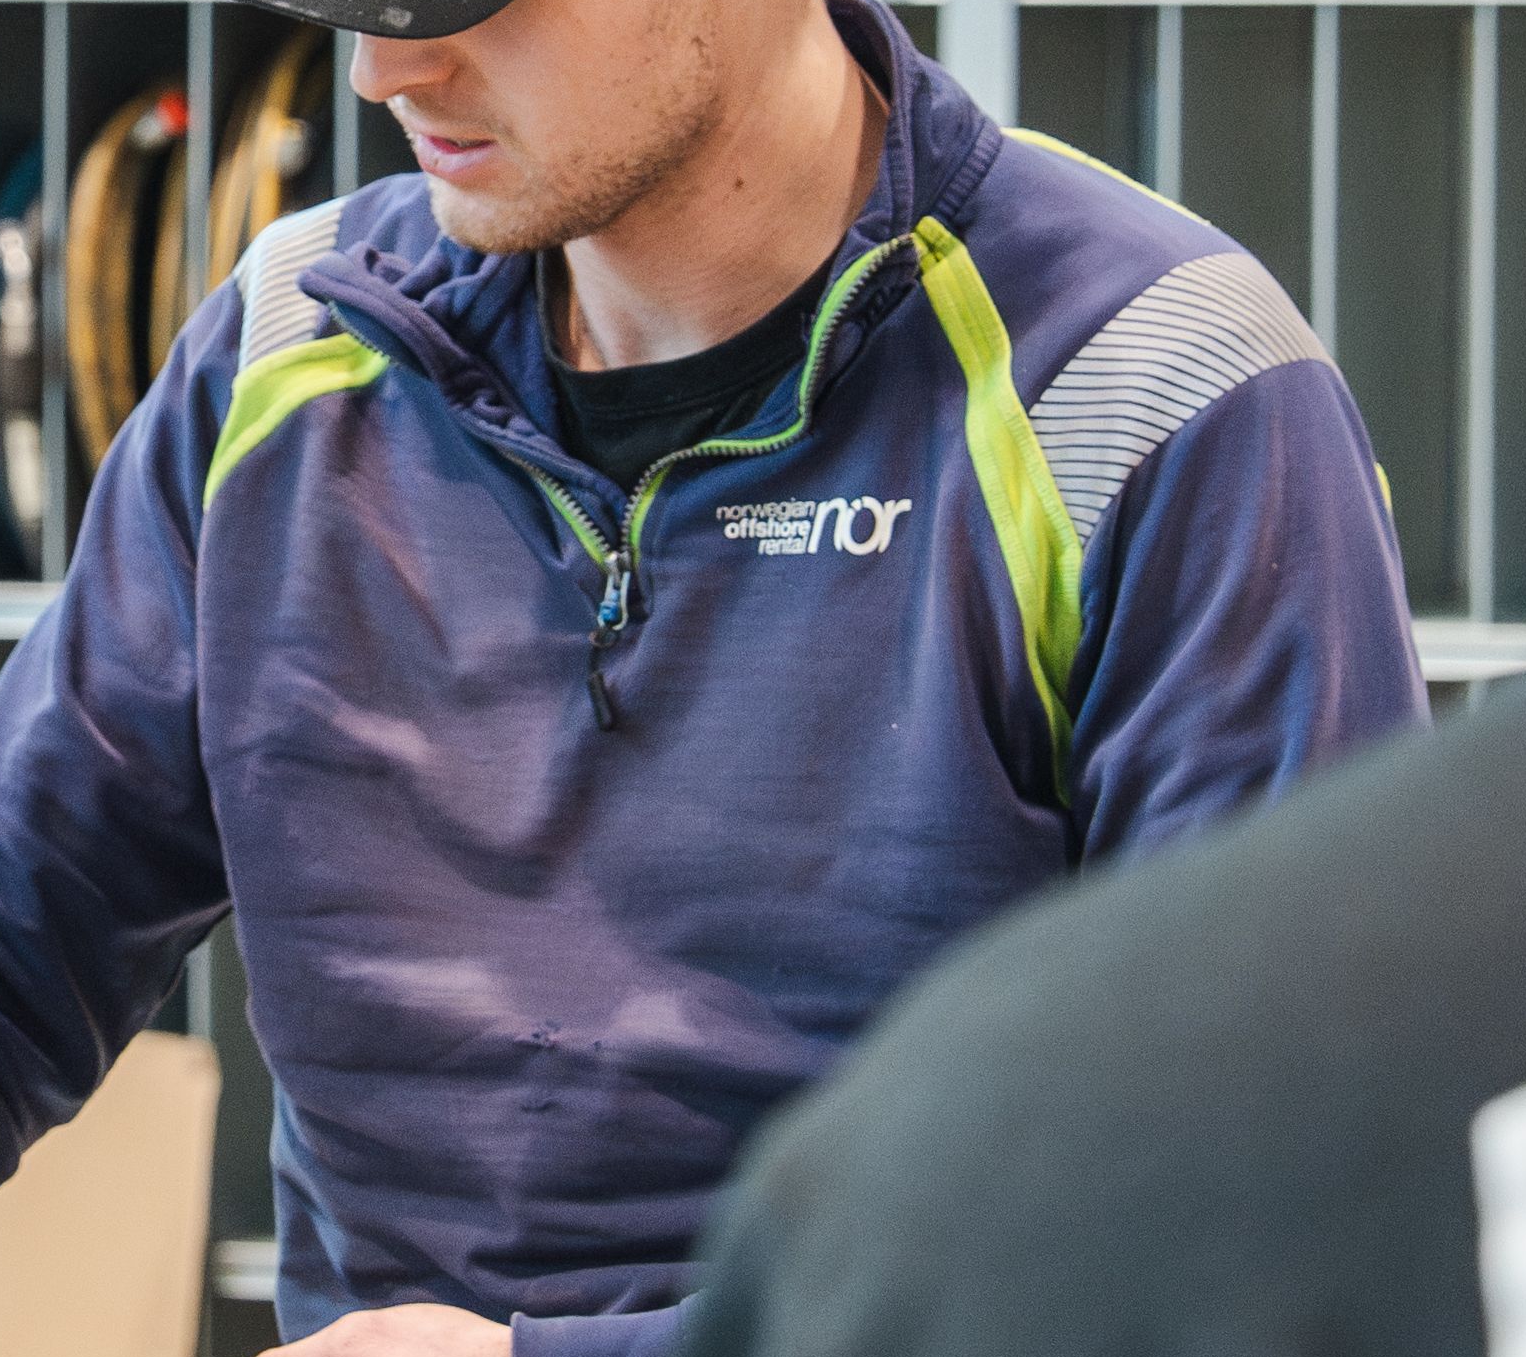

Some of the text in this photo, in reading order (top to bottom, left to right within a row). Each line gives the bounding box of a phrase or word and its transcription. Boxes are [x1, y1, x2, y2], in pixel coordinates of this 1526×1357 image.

[716, 497, 816, 521] norwegian
[724, 517, 812, 540] offshore
[807, 495, 913, 556] nor
[758, 536, 807, 556] rental
